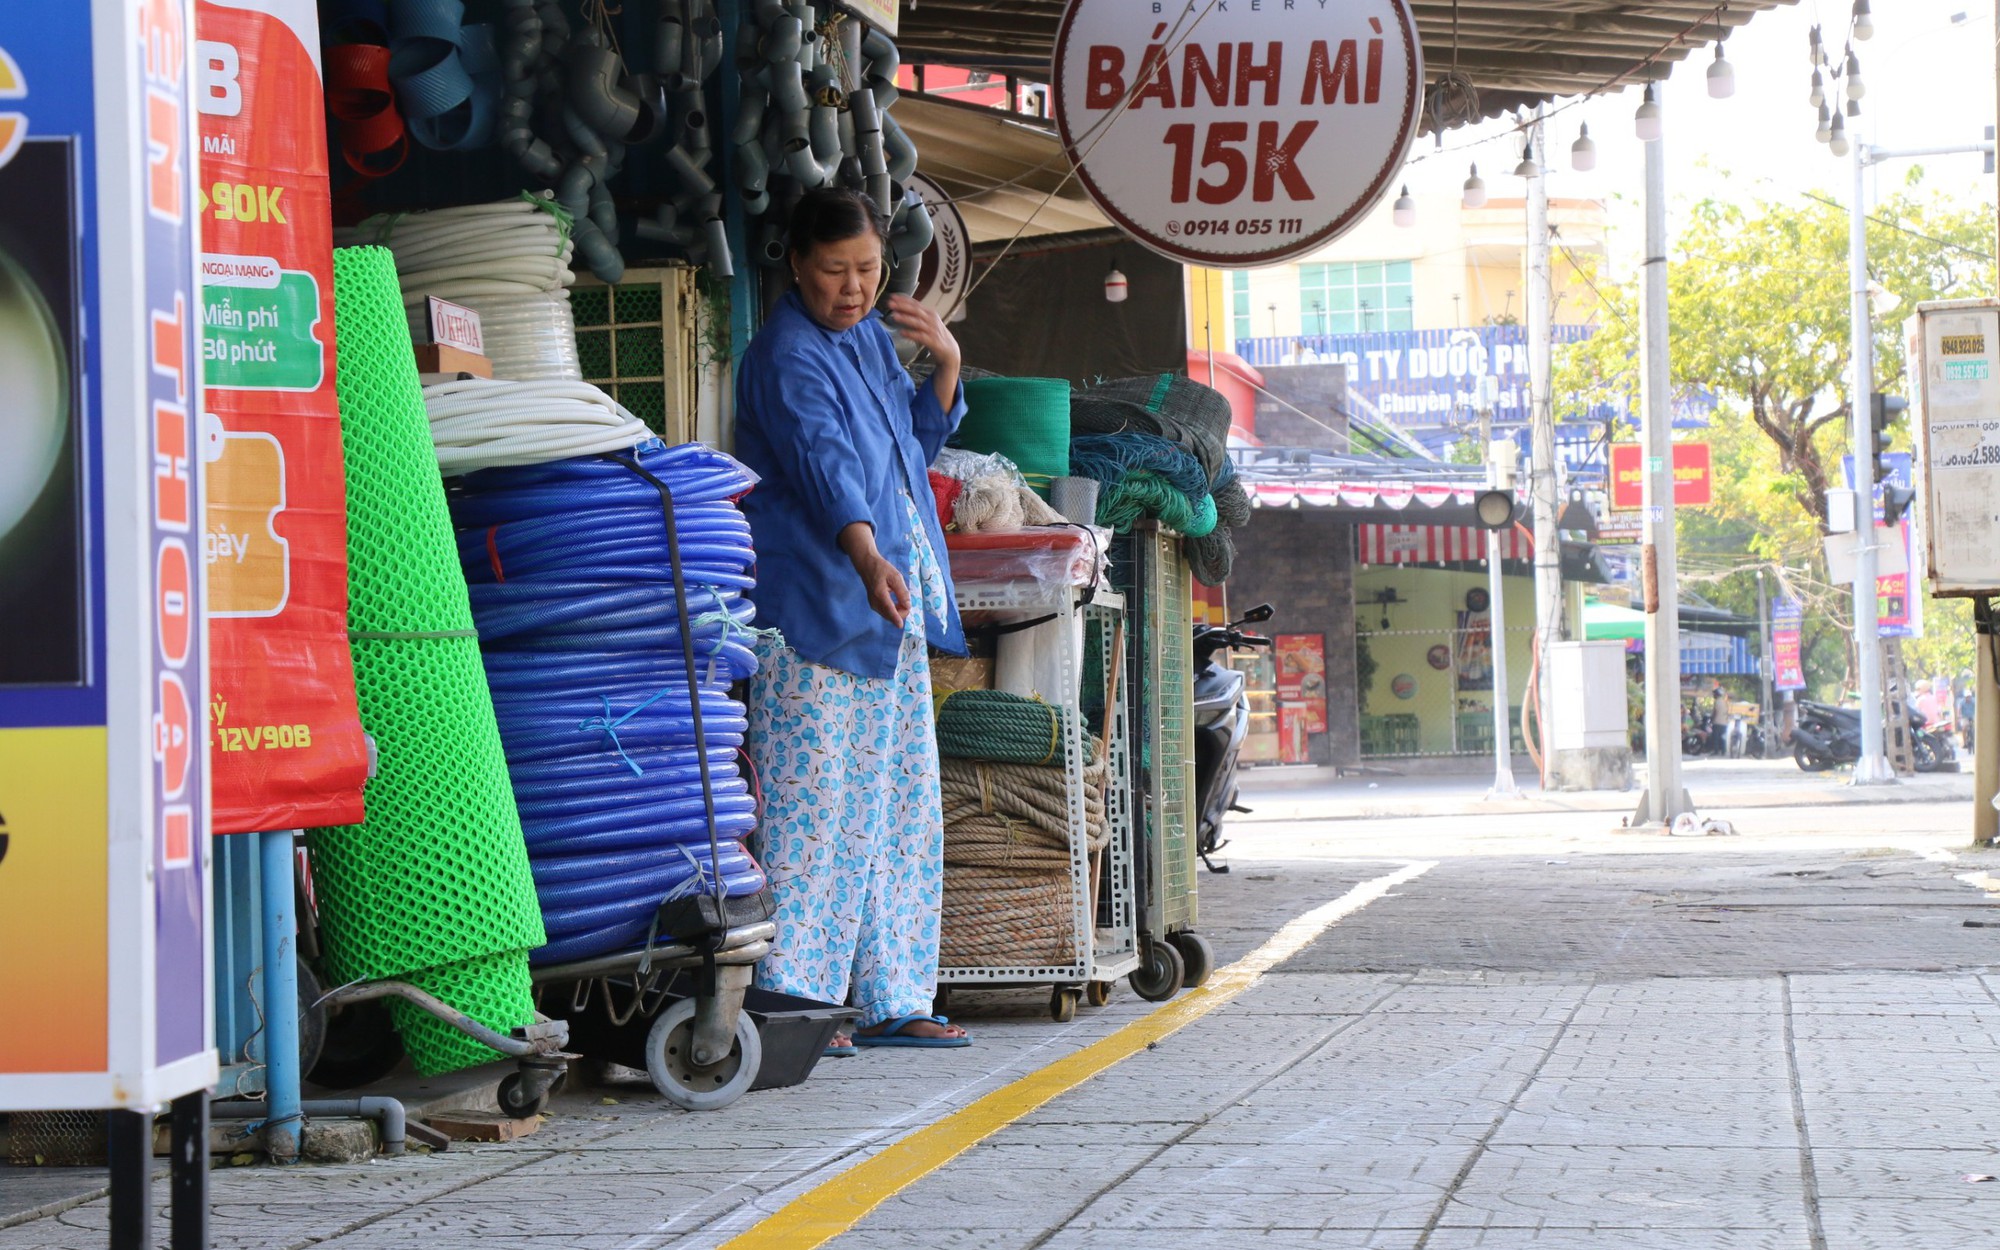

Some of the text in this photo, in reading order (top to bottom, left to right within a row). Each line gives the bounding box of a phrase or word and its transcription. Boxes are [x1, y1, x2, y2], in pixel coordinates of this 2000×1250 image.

[1152, 0, 1327, 14] BAKERY
[1086, 17, 1384, 110] BÁNH MÌ
[204, 133, 235, 155] MÃI
[1163, 120, 1319, 205] 15K
[212, 182, 287, 224] 90K
[1184, 218, 1303, 236] 0914 055 111
[202, 262, 269, 279] NGOẠI MẠNG
[202, 297, 279, 332] Miễn phí
[446, 311, 481, 348] KHÓA
[204, 338, 277, 366] 30 phút
[1366, 349, 1402, 382] TY
[1494, 343, 1529, 375] PH
[1378, 388, 1452, 415] Chuyên
[1982, 420, 2000, 431] GÓP
[207, 524, 250, 565] gày
[152, 291, 192, 869] THOẠI
[217, 724, 312, 752] 12V90B
